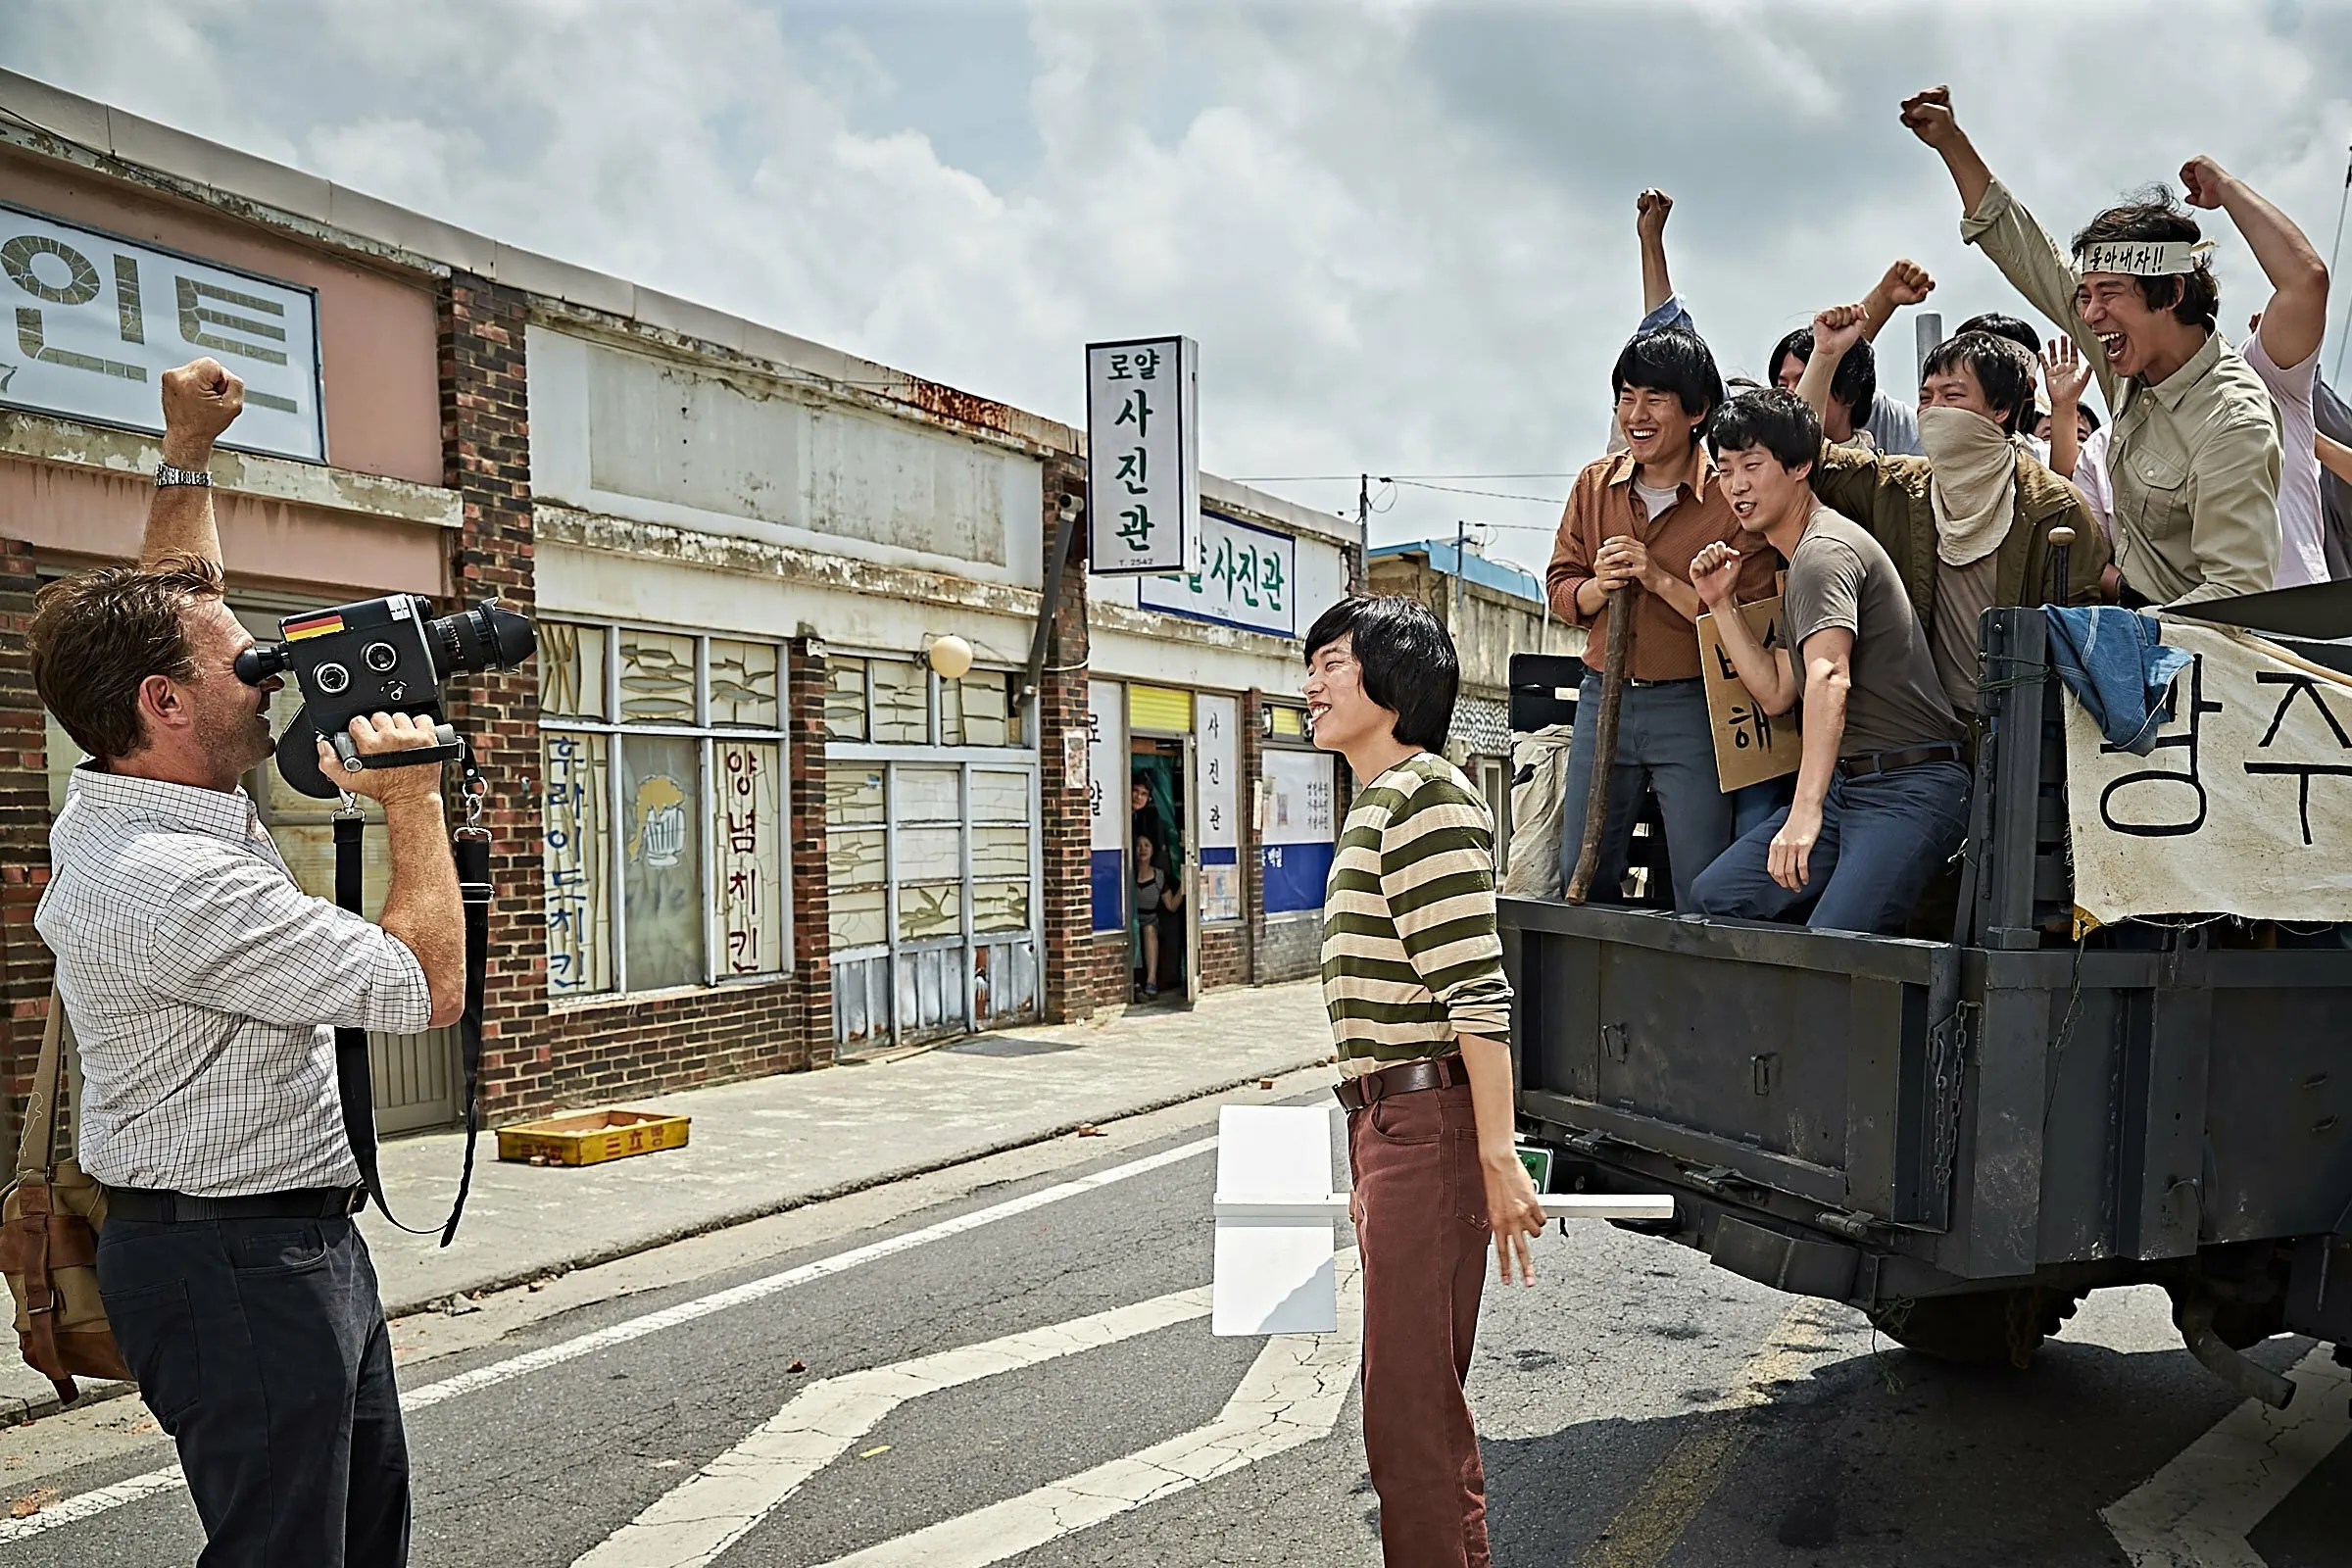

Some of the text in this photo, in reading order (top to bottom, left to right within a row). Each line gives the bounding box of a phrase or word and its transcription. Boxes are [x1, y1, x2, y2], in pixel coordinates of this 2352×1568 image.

[1106, 348, 1161, 381] 로얄
[1114, 388, 1155, 552] 사진관
[1210, 536, 1285, 612] 사진관
[1207, 712, 1222, 831] 사진관
[726, 750, 759, 974] 양념치킨
